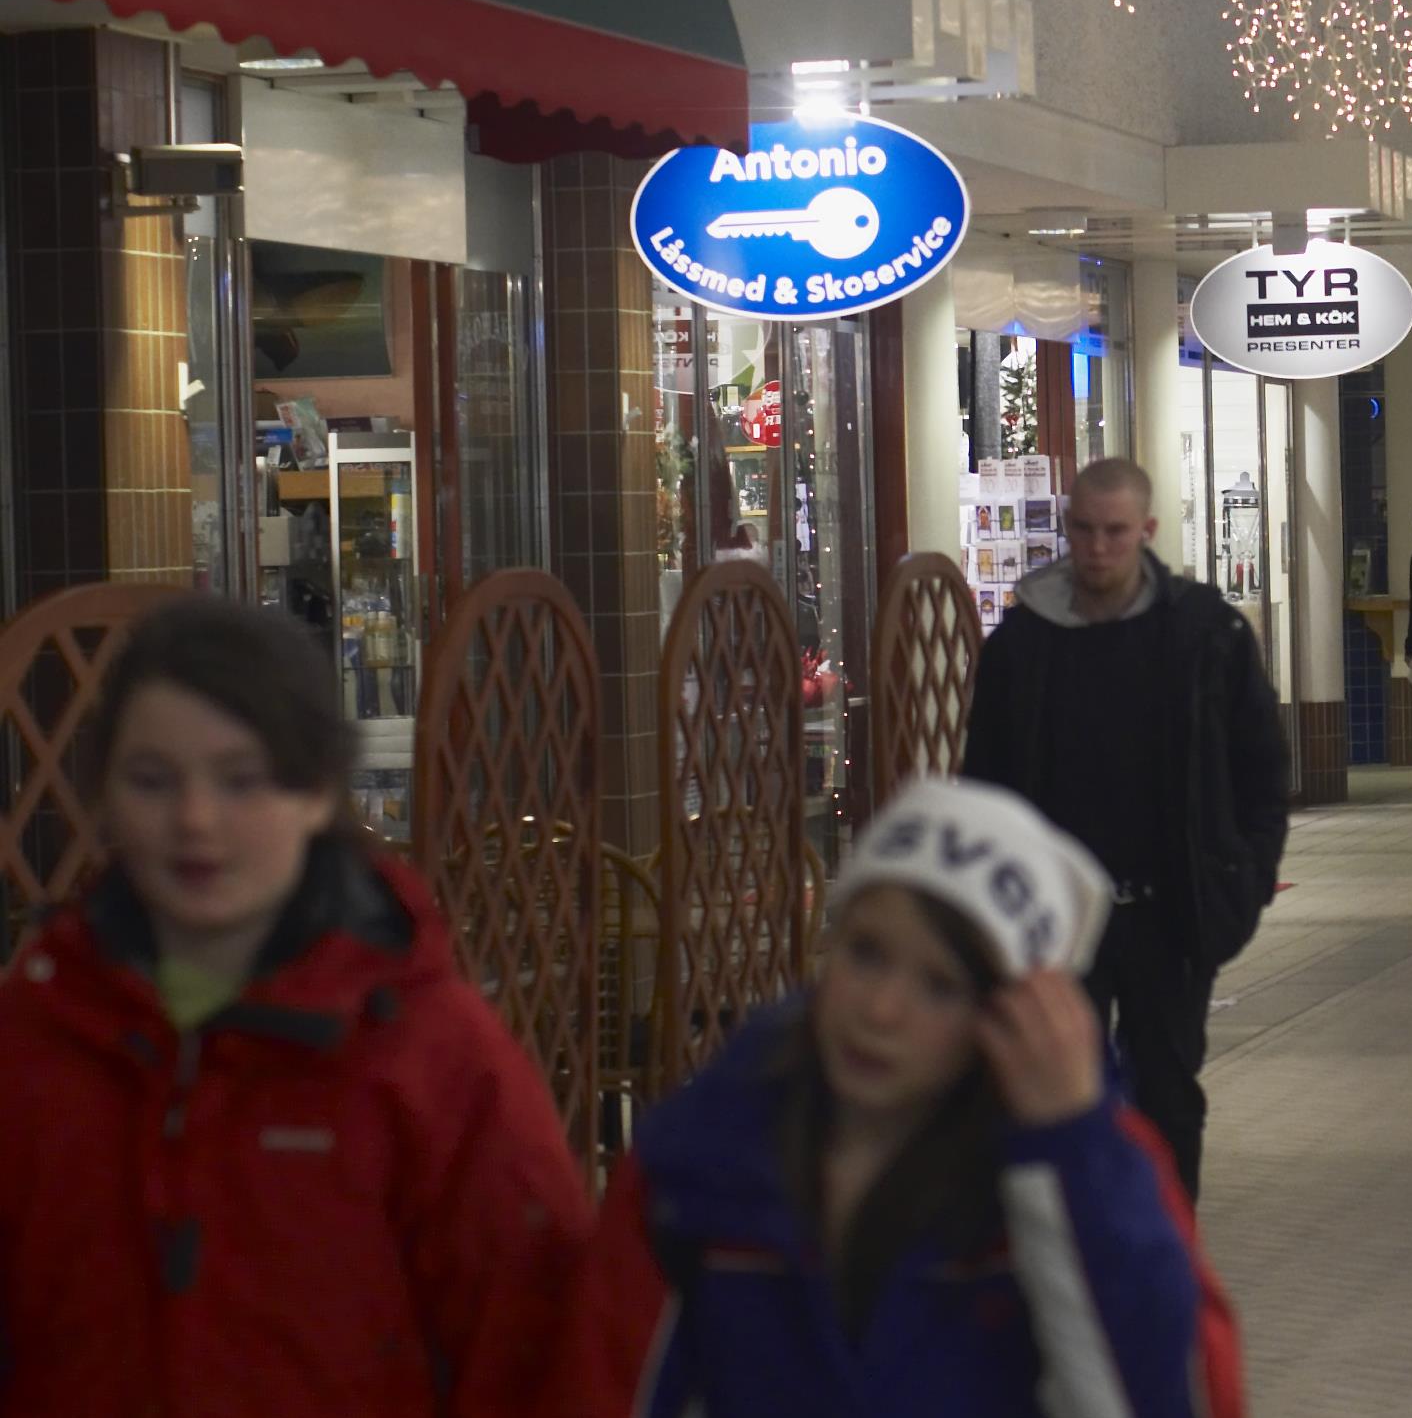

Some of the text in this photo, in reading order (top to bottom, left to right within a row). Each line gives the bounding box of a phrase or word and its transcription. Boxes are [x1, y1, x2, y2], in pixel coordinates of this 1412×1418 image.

[709, 136, 887, 183] Antonio
[649, 216, 953, 304] Låssmed & Skoservice
[1245, 267, 1359, 300] TYR
[1250, 309, 1356, 327] HEM & KÖK
[1247, 338, 1361, 353] PRESENTER
